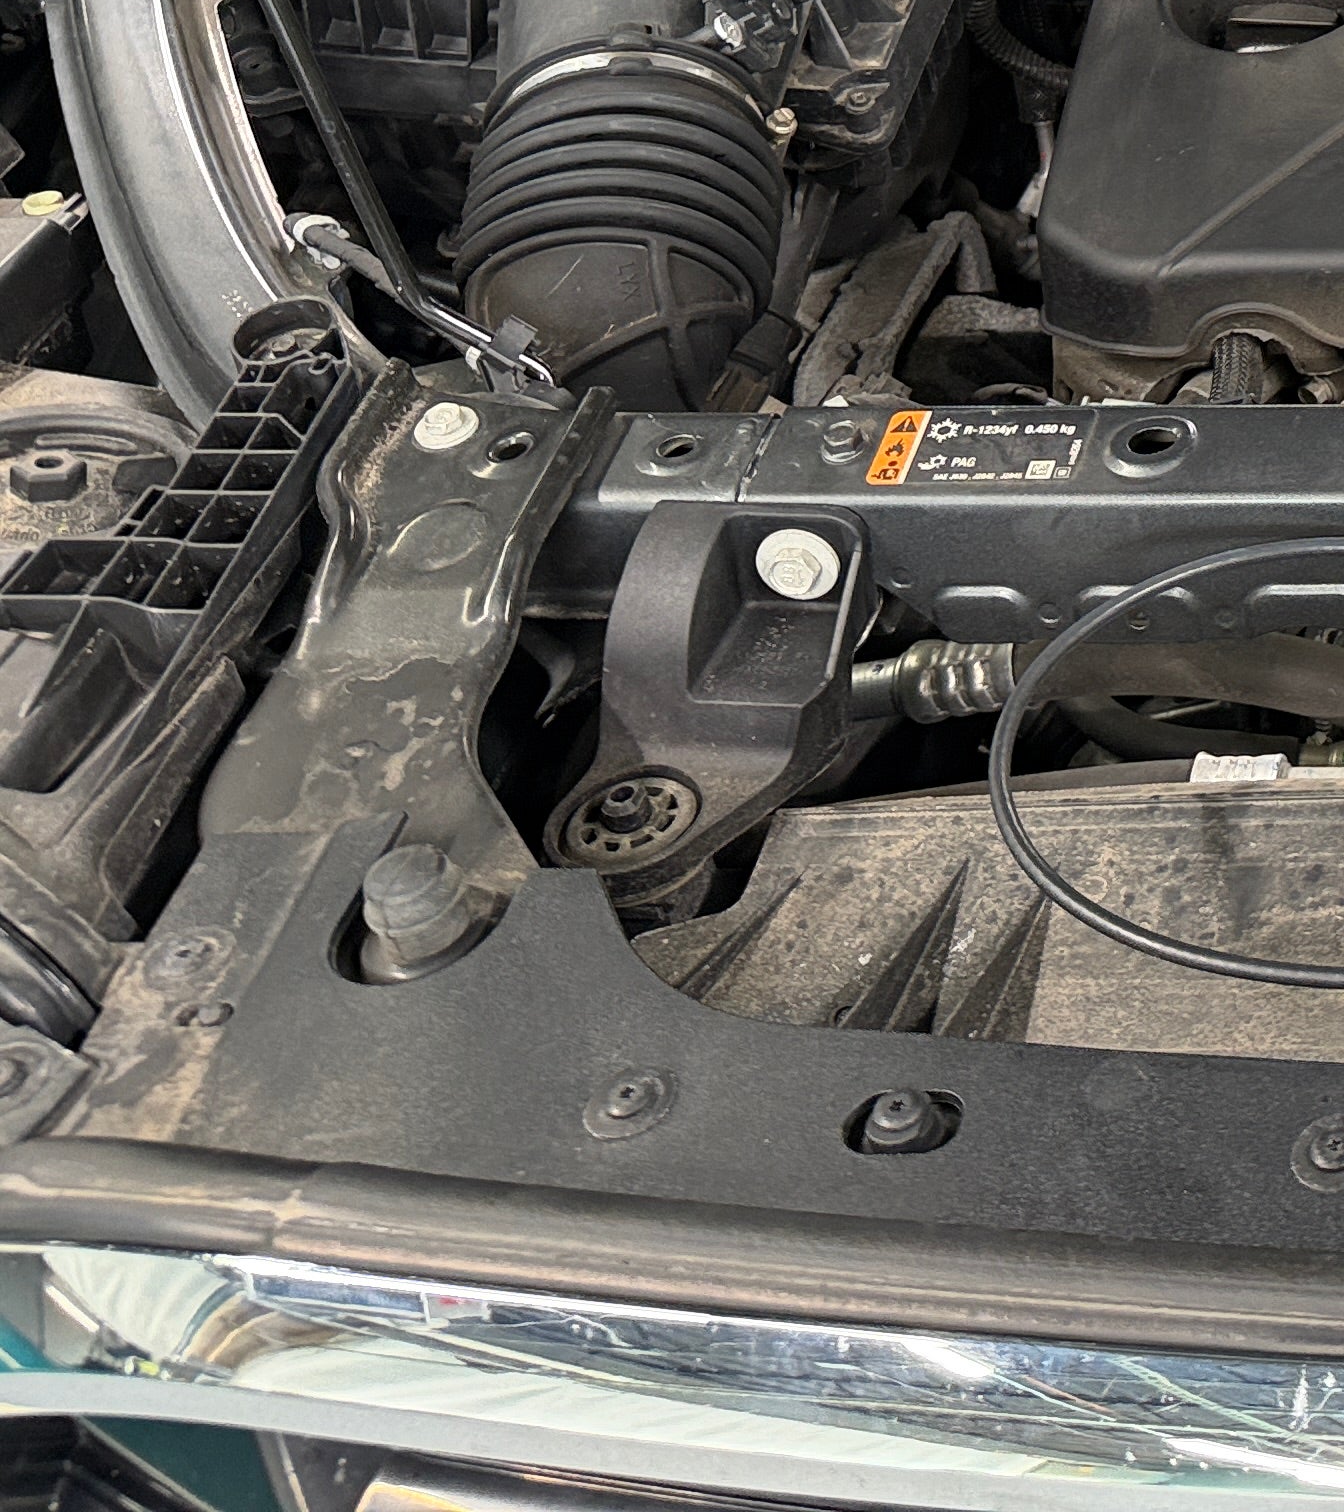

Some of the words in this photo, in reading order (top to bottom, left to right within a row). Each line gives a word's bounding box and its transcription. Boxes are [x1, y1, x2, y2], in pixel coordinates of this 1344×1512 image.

[963, 424, 1019, 436] R-1234yf
[1024, 424, 1058, 434] 0.450
[1059, 424, 1076, 435] kg
[951, 457, 977, 468] PAG
